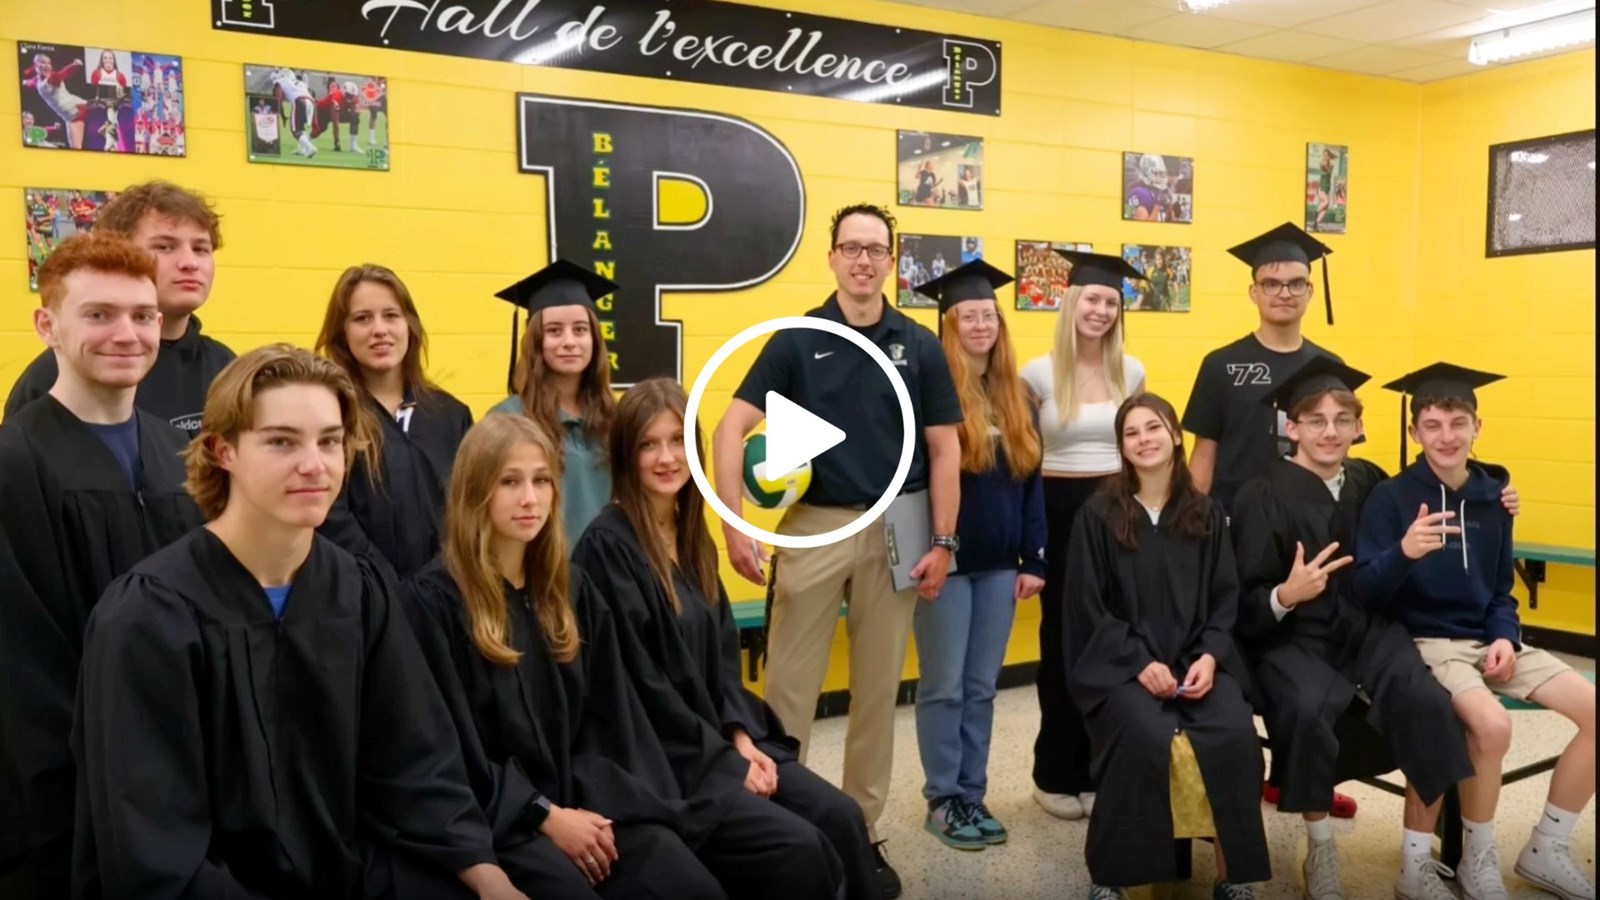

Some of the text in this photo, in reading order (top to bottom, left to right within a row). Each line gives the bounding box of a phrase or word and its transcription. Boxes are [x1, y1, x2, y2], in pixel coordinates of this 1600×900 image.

[361, 0, 540, 41] Hall
[554, 5, 623, 55] de
[1226, 362, 1272, 387] '72
